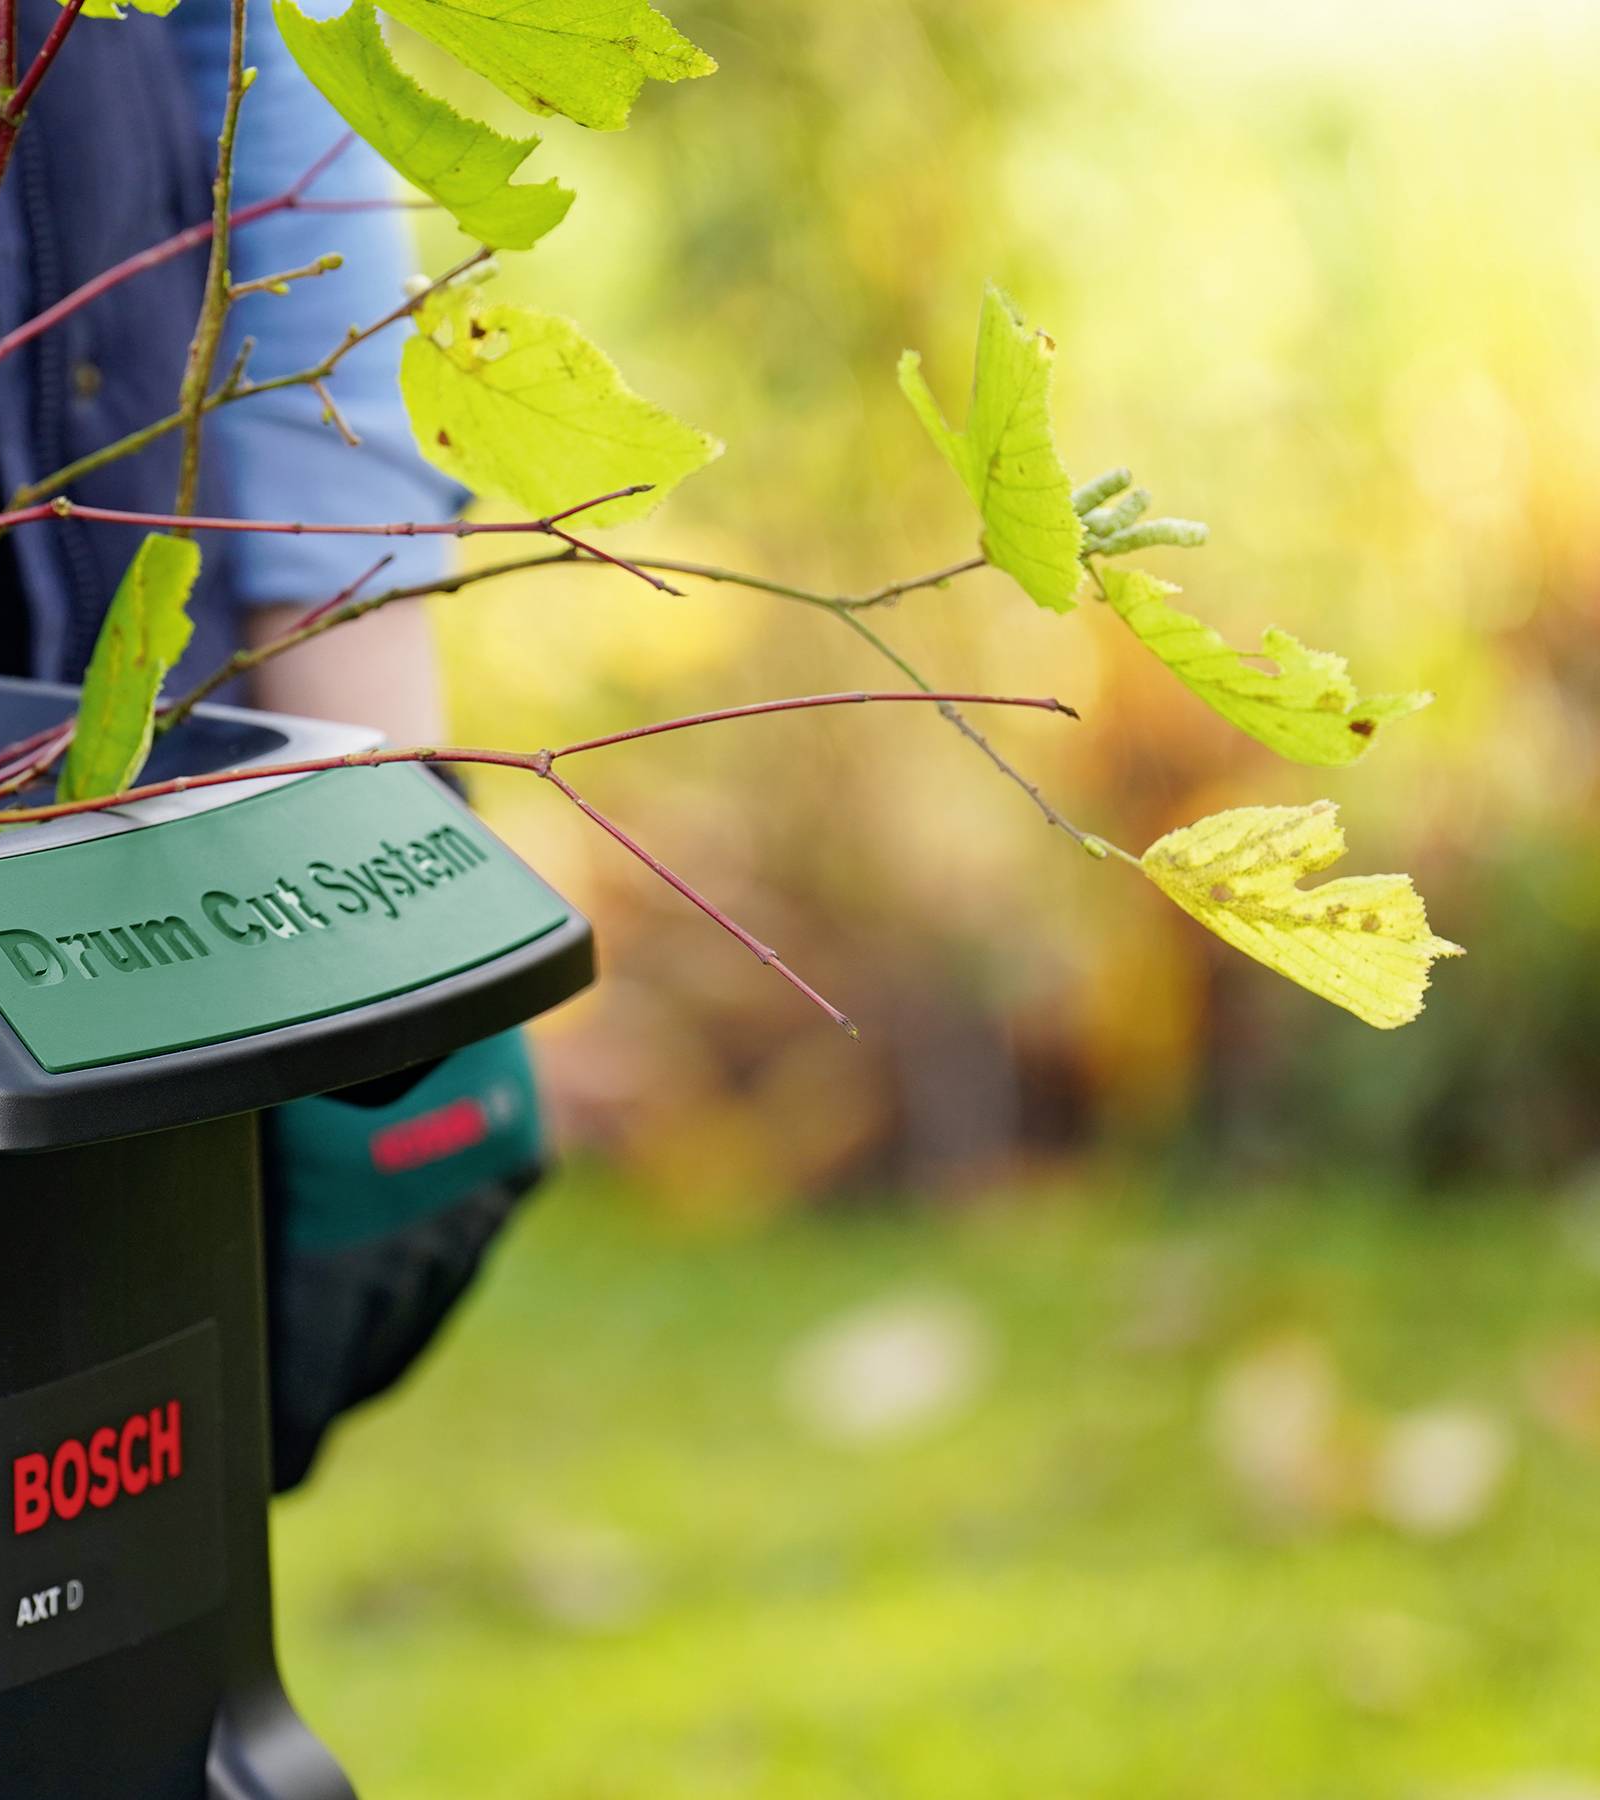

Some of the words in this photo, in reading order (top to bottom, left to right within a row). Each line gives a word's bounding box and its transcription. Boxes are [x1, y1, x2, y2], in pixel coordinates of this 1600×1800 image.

[200, 874, 331, 947] Cut
[308, 822, 489, 919] System
[13, 1399, 182, 1535] BOSCH
[16, 1585, 61, 1628] AXT
[65, 1578, 84, 1611] D
